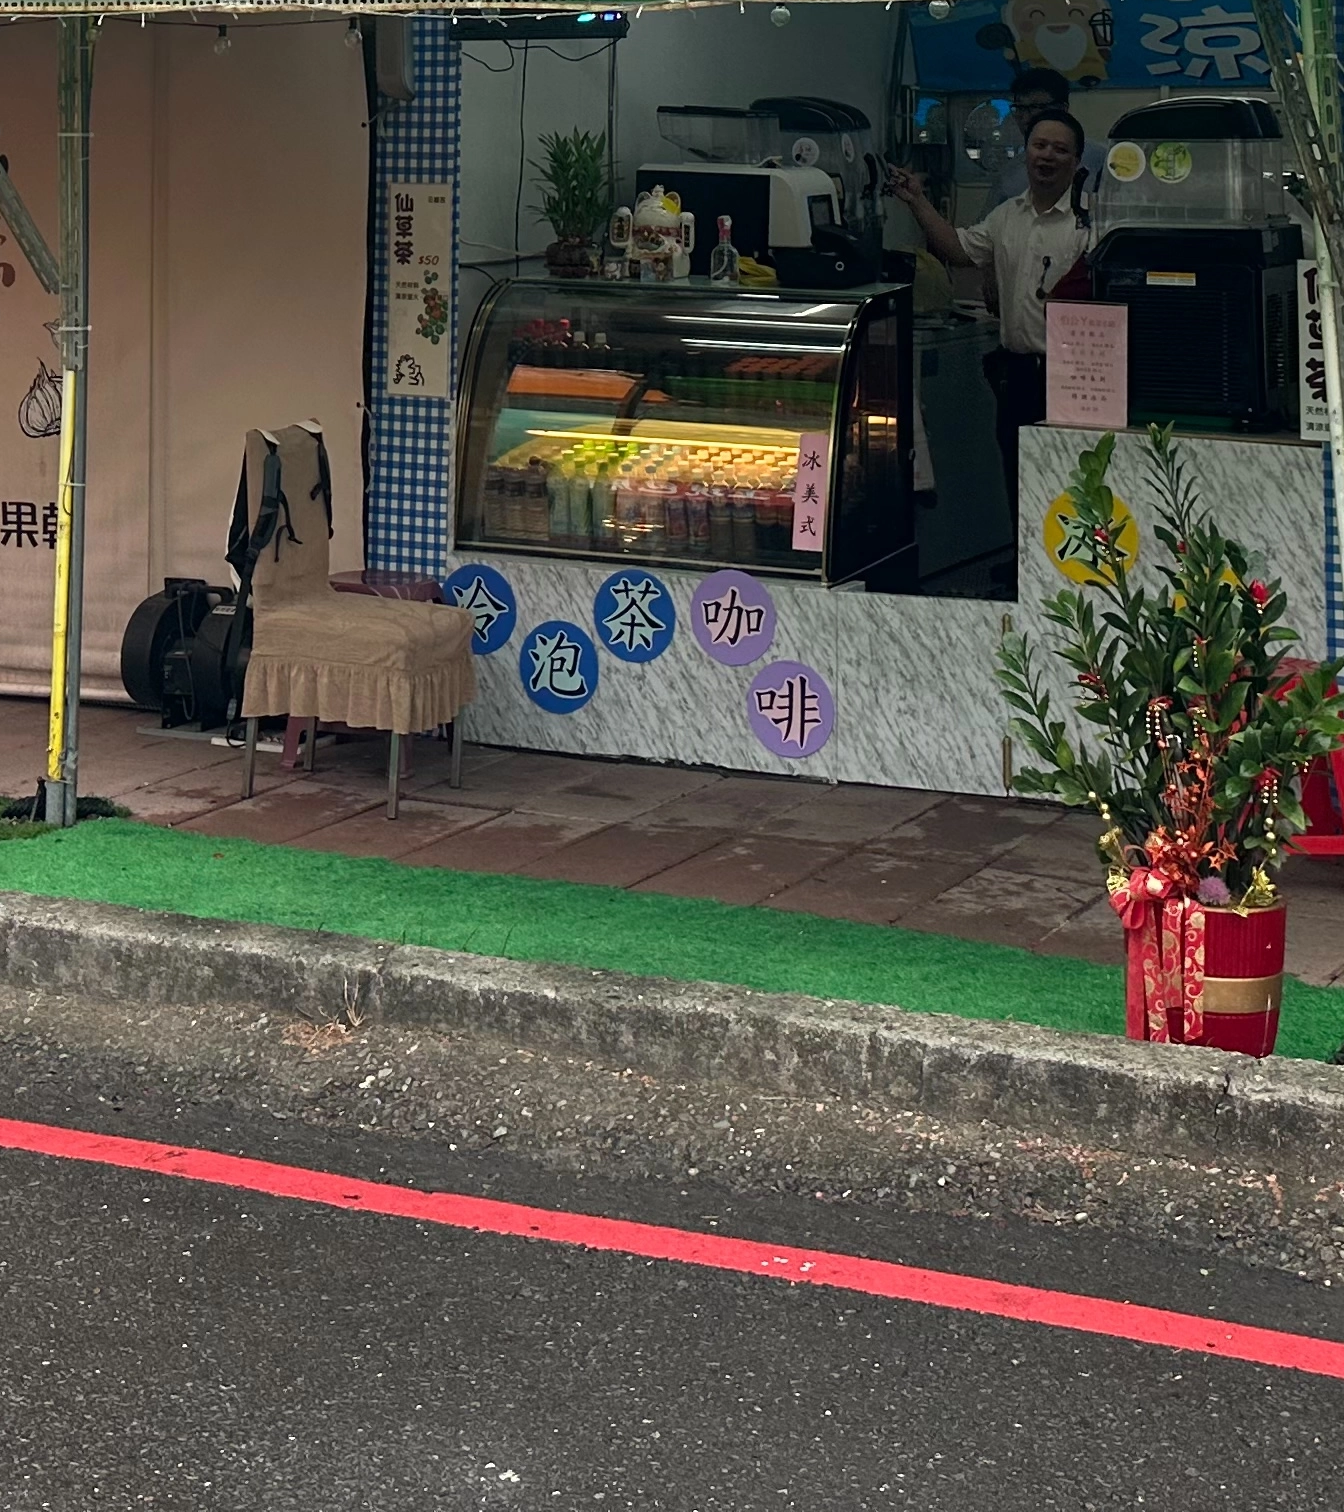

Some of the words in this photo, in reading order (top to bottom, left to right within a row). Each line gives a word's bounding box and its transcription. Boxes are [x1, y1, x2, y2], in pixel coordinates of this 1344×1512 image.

[394, 192, 414, 265] 仙草茶
[418, 254, 439, 265] $50
[799, 450, 822, 537] 冰美式
[703, 589, 821, 749] 咖啡
